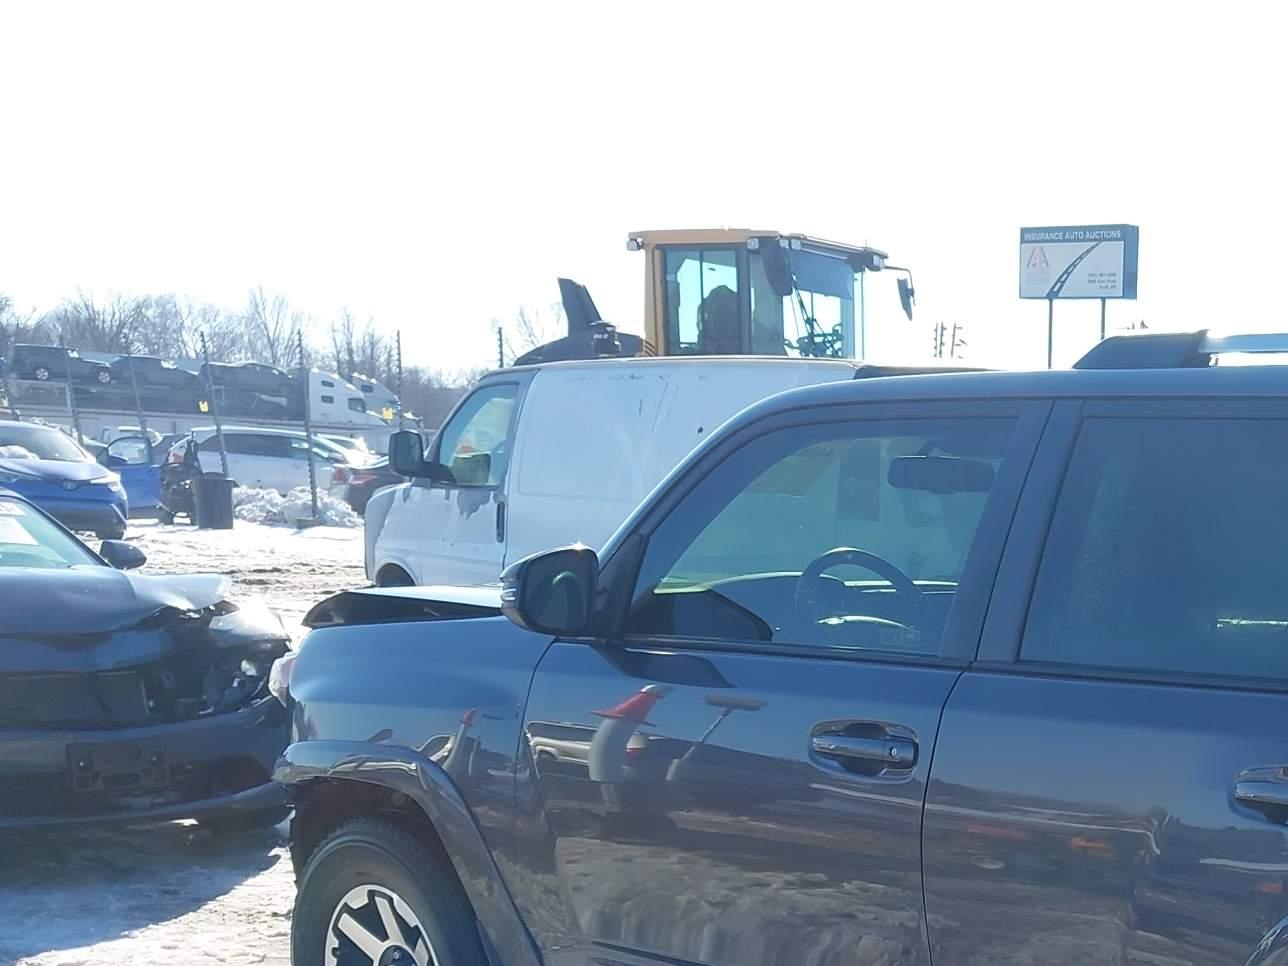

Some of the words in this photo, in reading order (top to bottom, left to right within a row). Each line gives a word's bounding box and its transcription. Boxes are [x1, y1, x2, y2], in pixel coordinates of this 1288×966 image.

[1024, 232, 1064, 241] INSURANCE
[1065, 231, 1084, 240] AUTO
[1085, 230, 1121, 240] AUCTIONS
